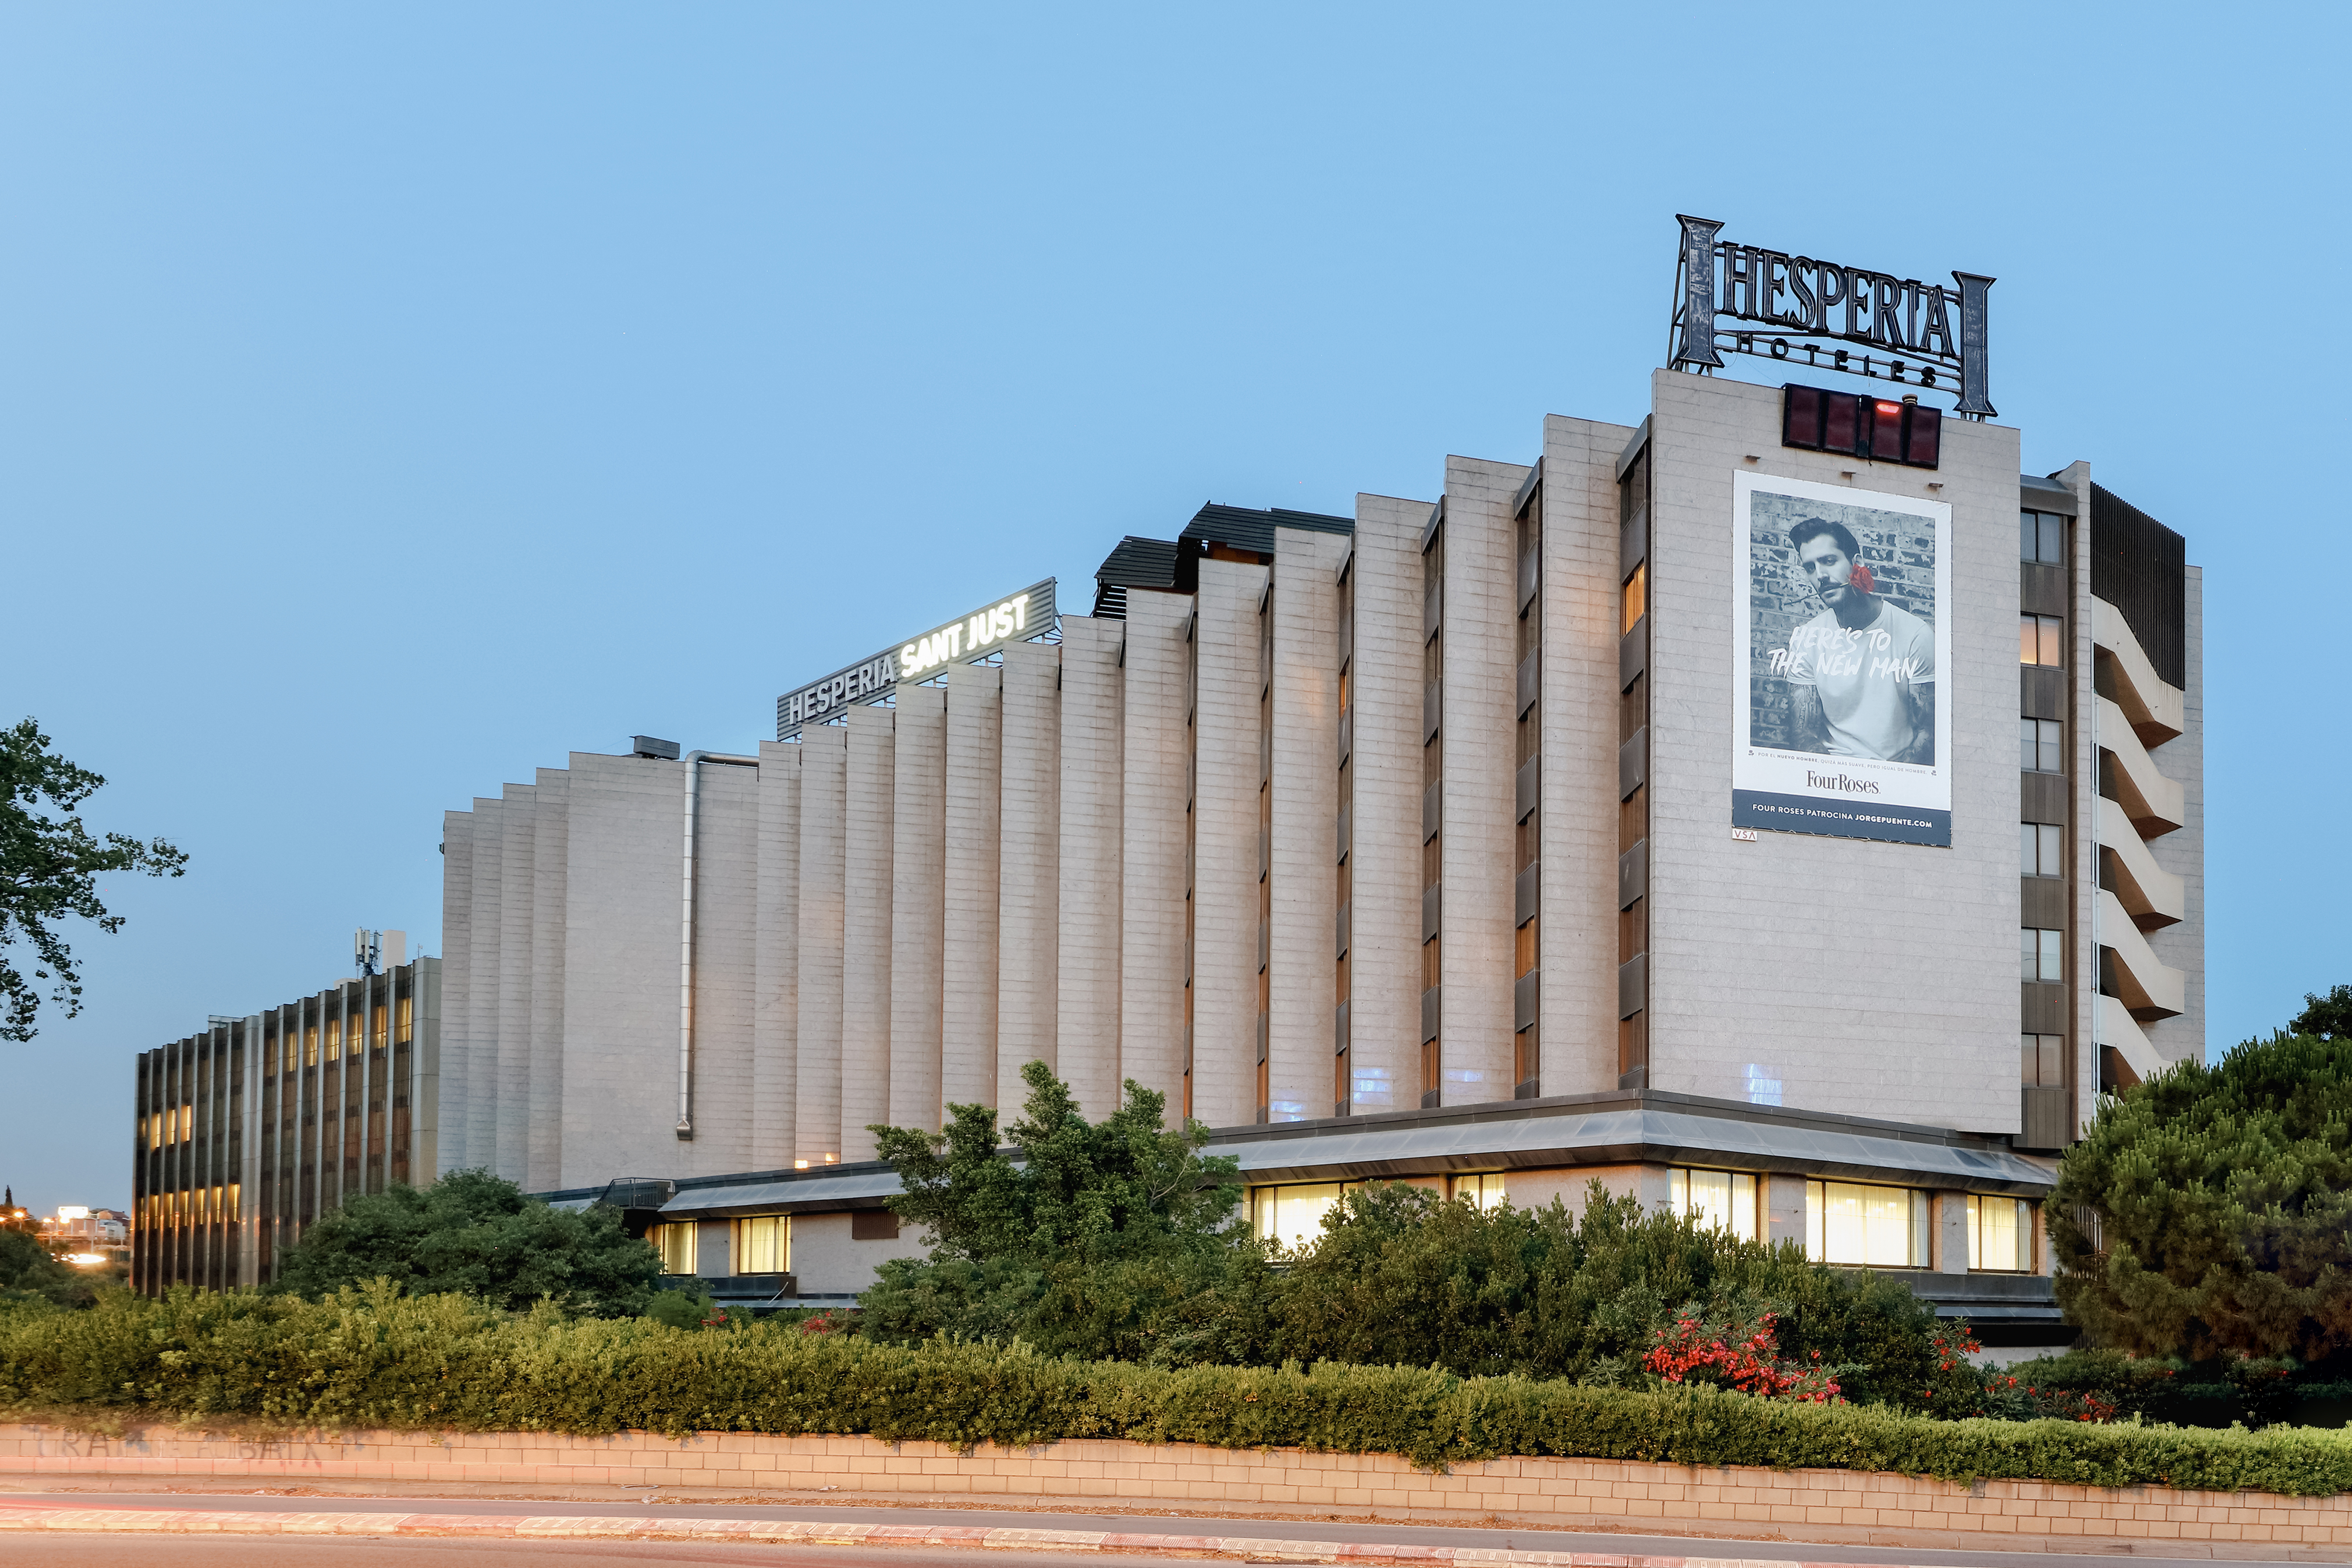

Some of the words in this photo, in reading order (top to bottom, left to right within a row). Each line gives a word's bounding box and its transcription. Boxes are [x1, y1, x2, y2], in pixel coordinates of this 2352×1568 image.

[1722, 241, 1957, 358] HESPERIA
[1737, 331, 1936, 387] HOTELES
[1789, 626, 1863, 654] HERE'S
[1866, 629, 1891, 653] TO
[789, 654, 898, 724] HESPERIA
[900, 622, 963, 678] SANT
[966, 594, 1029, 650] JUST
[1767, 648, 1808, 679] THE
[1816, 652, 1862, 676] NEW
[1868, 656, 1920, 682] MAN
[1778, 806, 1805, 815] ROSES
[1807, 810, 1853, 820] PATROCINA
[1855, 814, 1933, 828] JORGEPUENTE.COM
[1734, 830, 1756, 840] VSA
